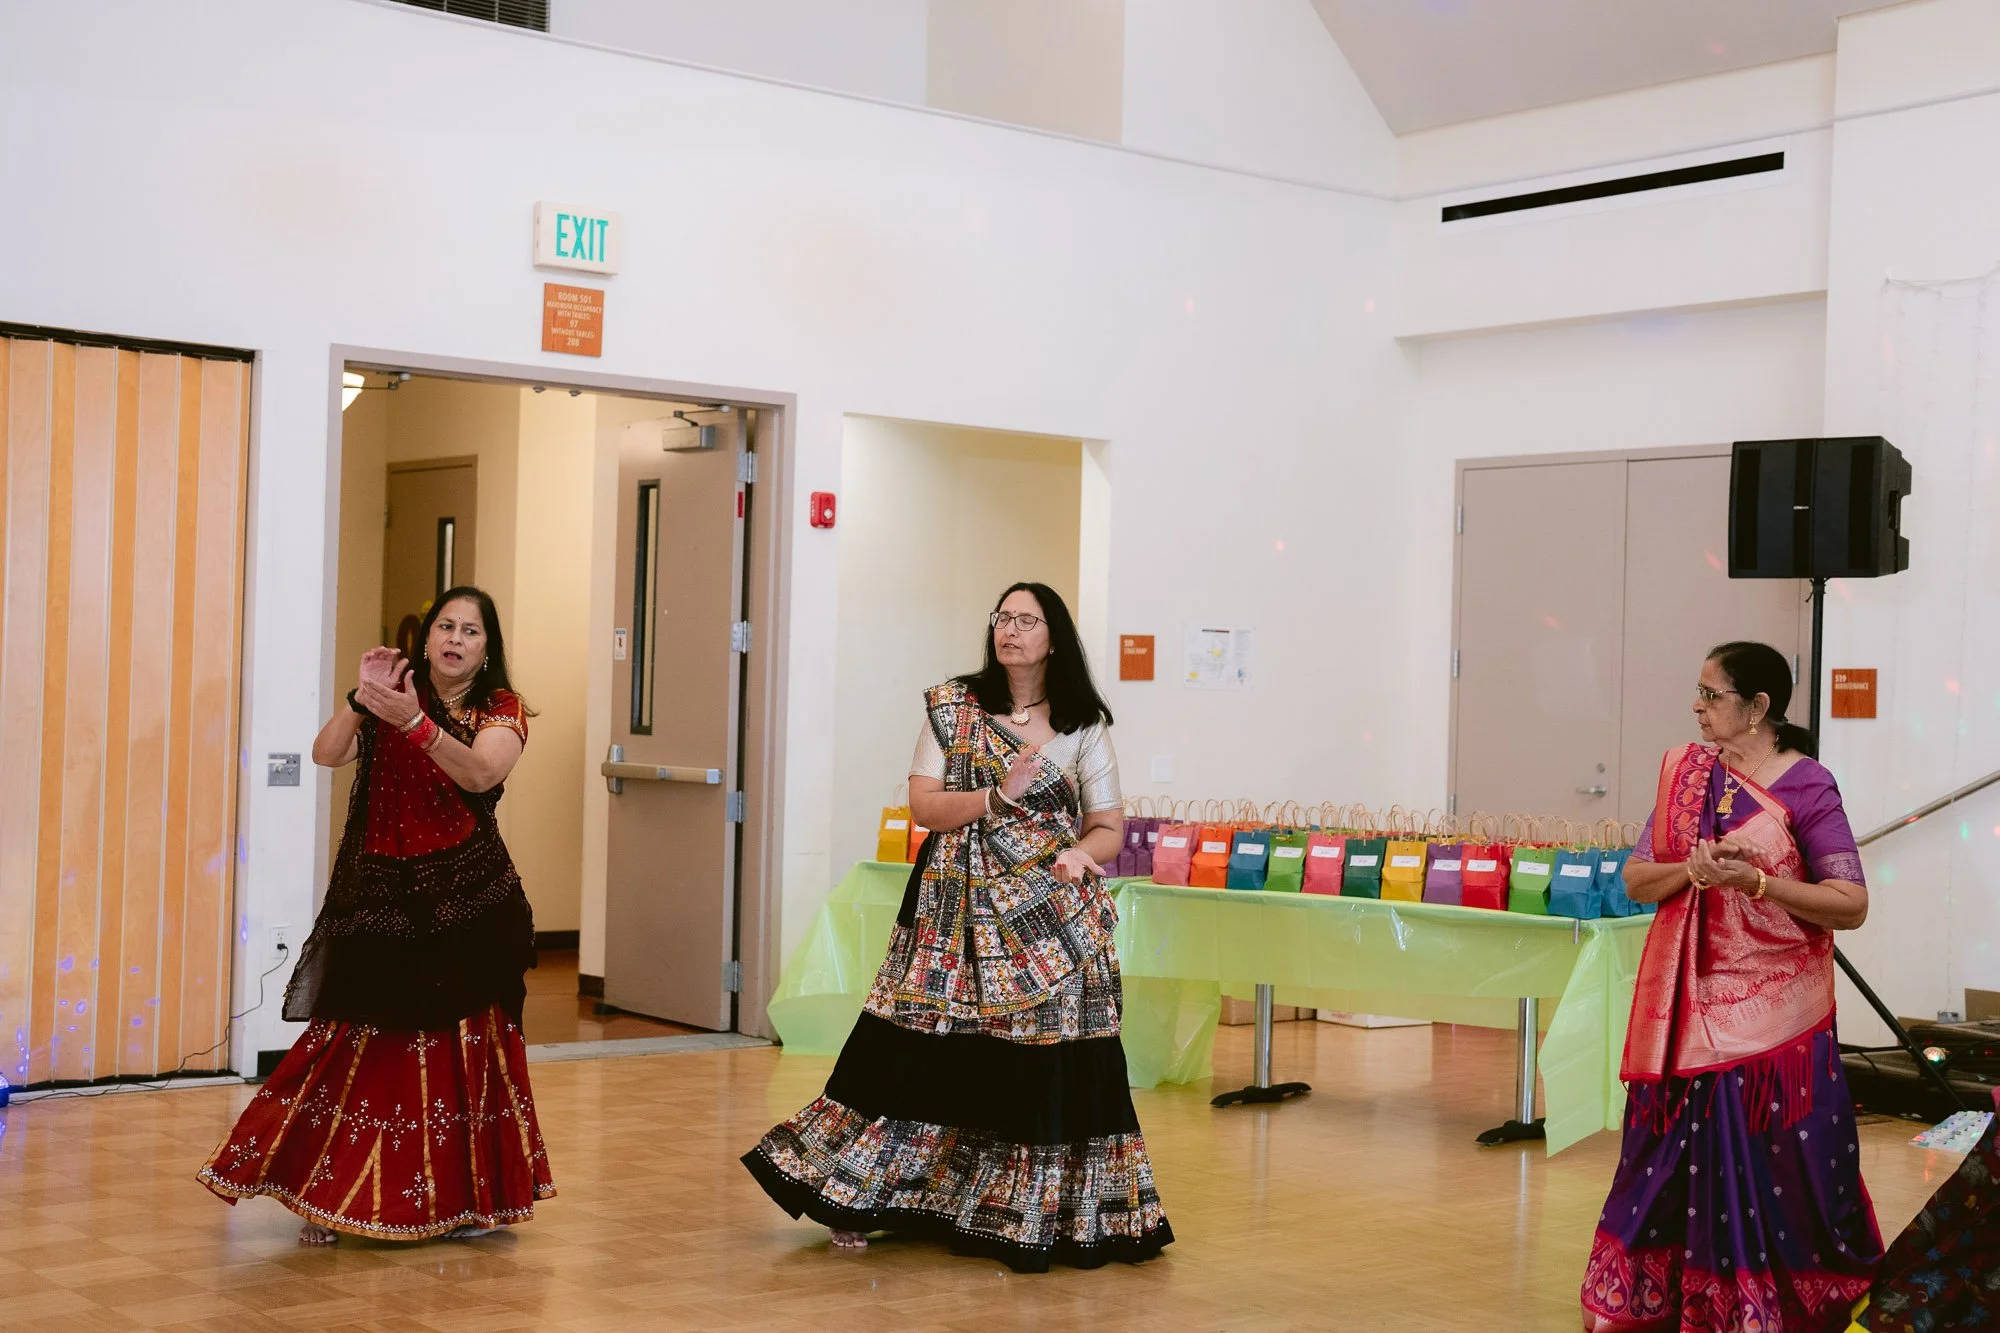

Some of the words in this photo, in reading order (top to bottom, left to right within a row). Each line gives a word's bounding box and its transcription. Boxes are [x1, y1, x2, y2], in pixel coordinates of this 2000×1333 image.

[556, 213, 608, 262] EXIT
[558, 291, 578, 302] ROOM
[579, 294, 592, 304] 501
[546, 300, 572, 309] MAXIMUM
[573, 304, 602, 313] OCCUPANCY
[569, 319, 579, 328] 97
[551, 328, 575, 336] WITHOUT
